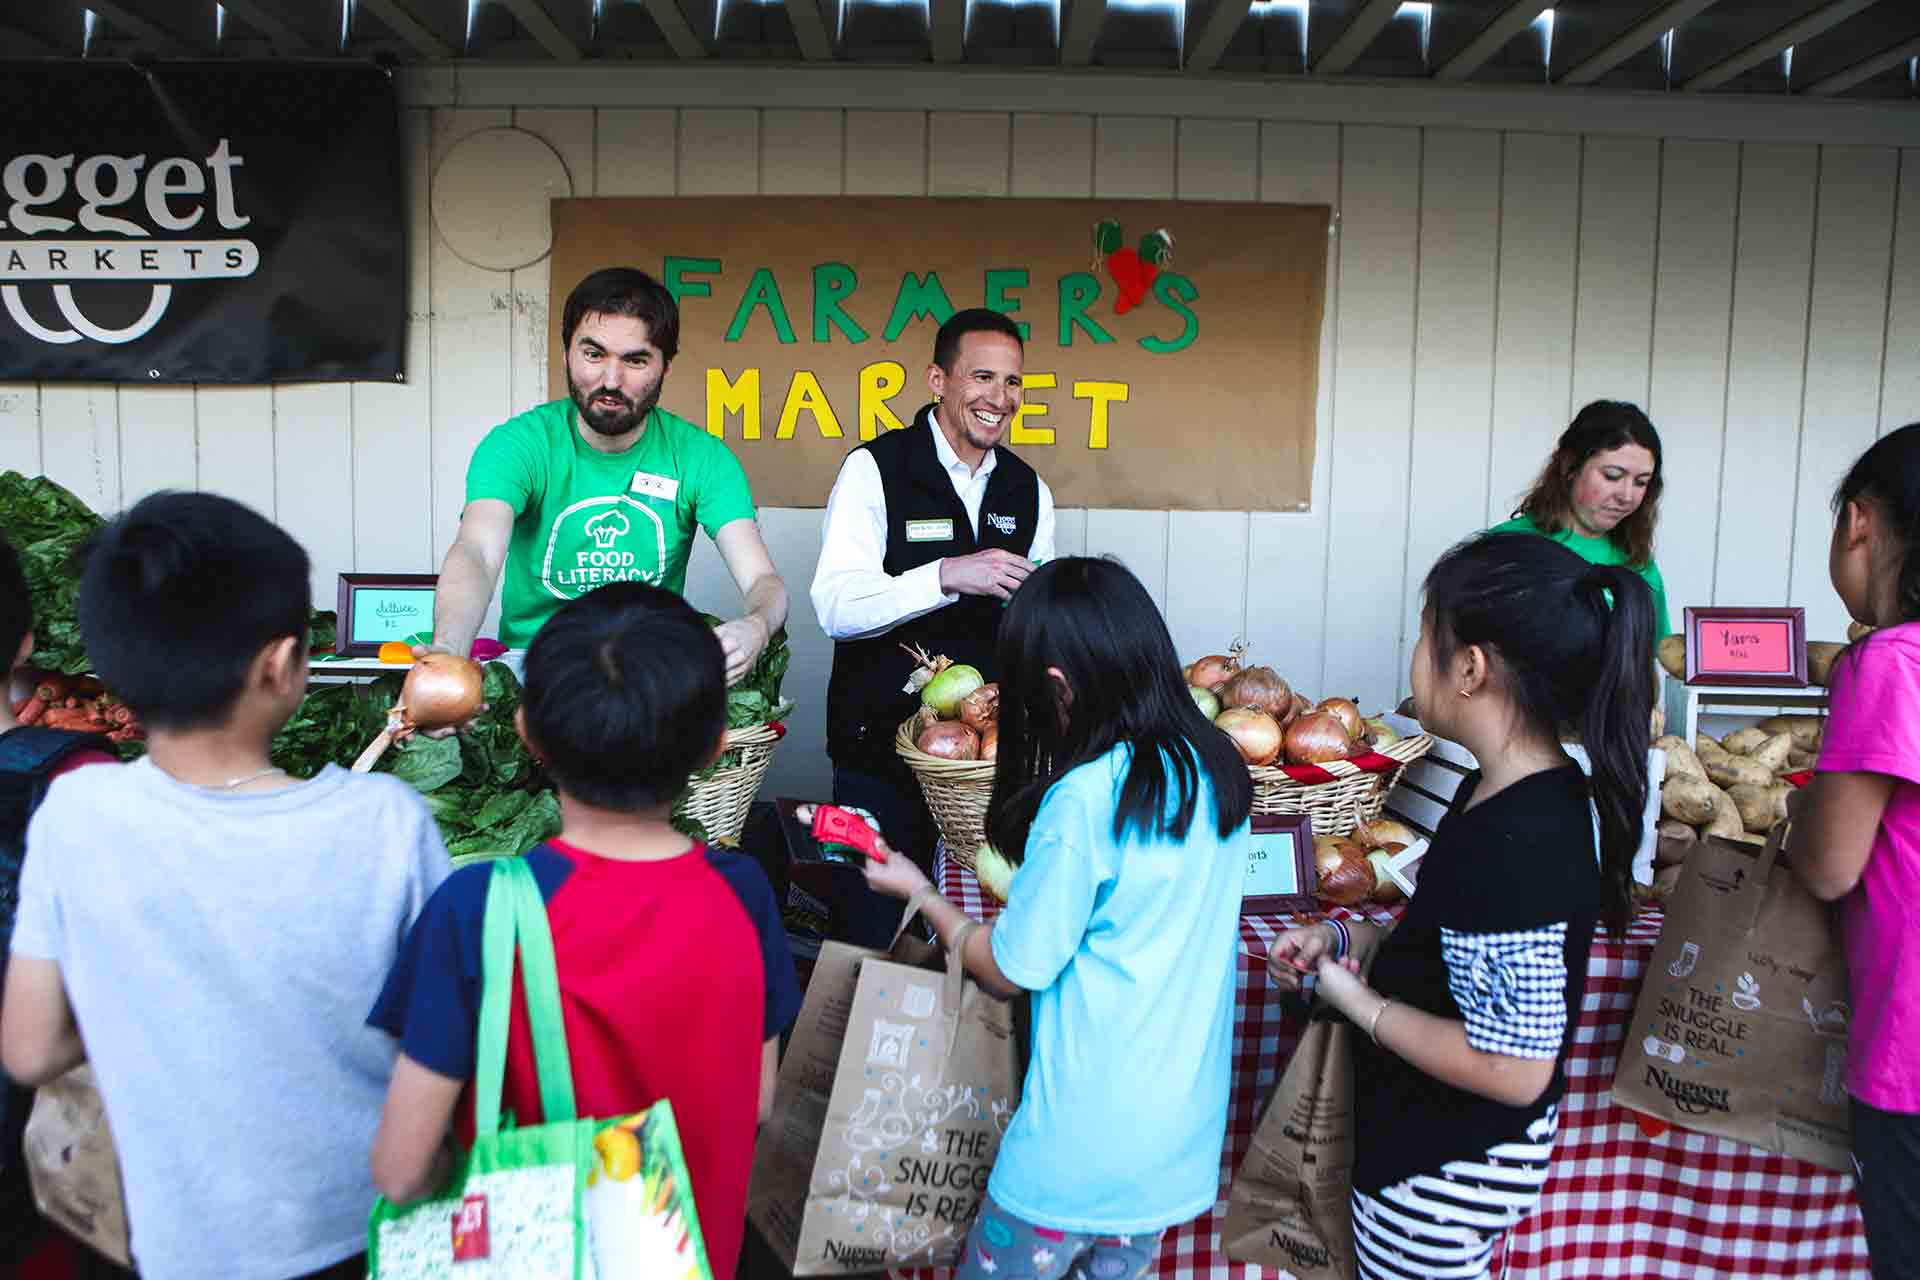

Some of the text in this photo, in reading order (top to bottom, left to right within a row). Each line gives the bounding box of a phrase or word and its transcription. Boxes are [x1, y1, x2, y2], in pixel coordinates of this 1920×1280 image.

[0, 138, 251, 236] gget
[7, 247, 244, 271] ARKETS
[705, 360, 1129, 450] MARET
[576, 551, 635, 568] FOOD
[557, 568, 654, 585] LITERACY
[1689, 986, 1723, 1013] THE
[1656, 998, 1749, 1041] SNUGGLE
[1664, 1021, 1680, 1041] IS
[945, 1128, 990, 1159] THE
[895, 1157, 992, 1191] SNUGG
[905, 1192, 930, 1218] IS
[934, 1195, 980, 1223] REA
